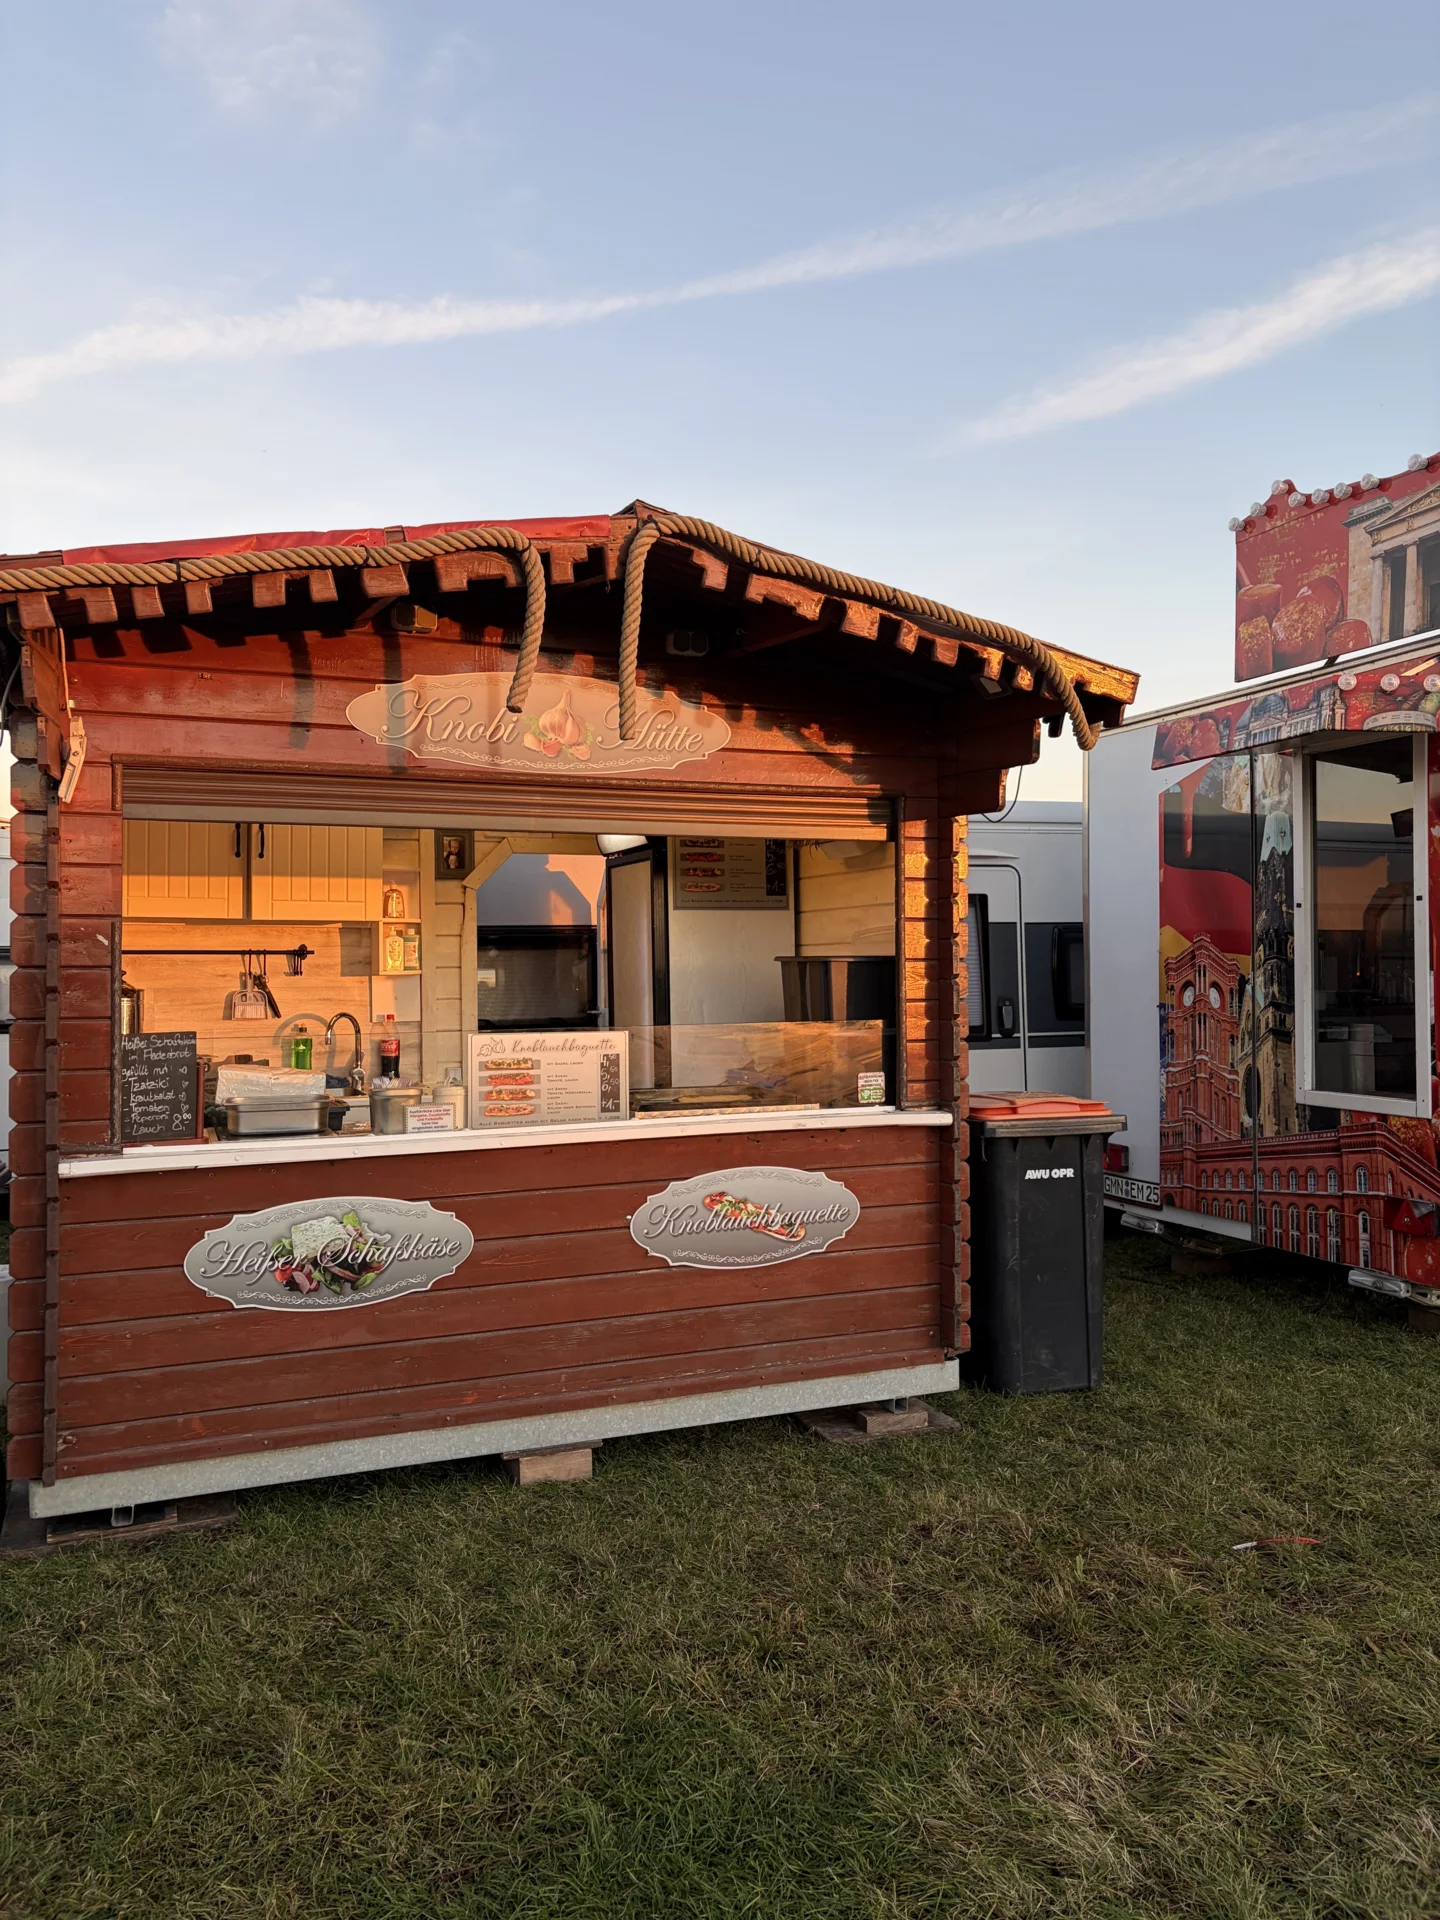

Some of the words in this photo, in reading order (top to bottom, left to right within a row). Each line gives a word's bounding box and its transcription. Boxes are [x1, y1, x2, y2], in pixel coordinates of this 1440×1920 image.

[381, 687, 518, 743] Knobi
[597, 702, 704, 752] Hütte
[128, 1053, 138, 1061] im
[143, 1047, 192, 1061] Fladenbrot
[512, 1038, 616, 1058] Knoblauchbaguette
[121, 1064, 149, 1081] gefüllt
[128, 1077, 170, 1092] Tzatziki
[129, 1102, 170, 1113] Tomaten
[131, 1112, 170, 1123] Peperoni
[132, 1124, 165, 1135] Lauch
[1025, 1168, 1049, 1180] AWU
[1051, 1168, 1075, 1179] OPR
[1104, 1176, 1124, 1197] GMN
[1130, 1184, 1144, 1201] EM
[1146, 1187, 1160, 1204] 25
[643, 1203, 849, 1240] Knoblauchbaguette
[200, 1238, 308, 1285] Heißer
[317, 1232, 463, 1273] Schafskäse
